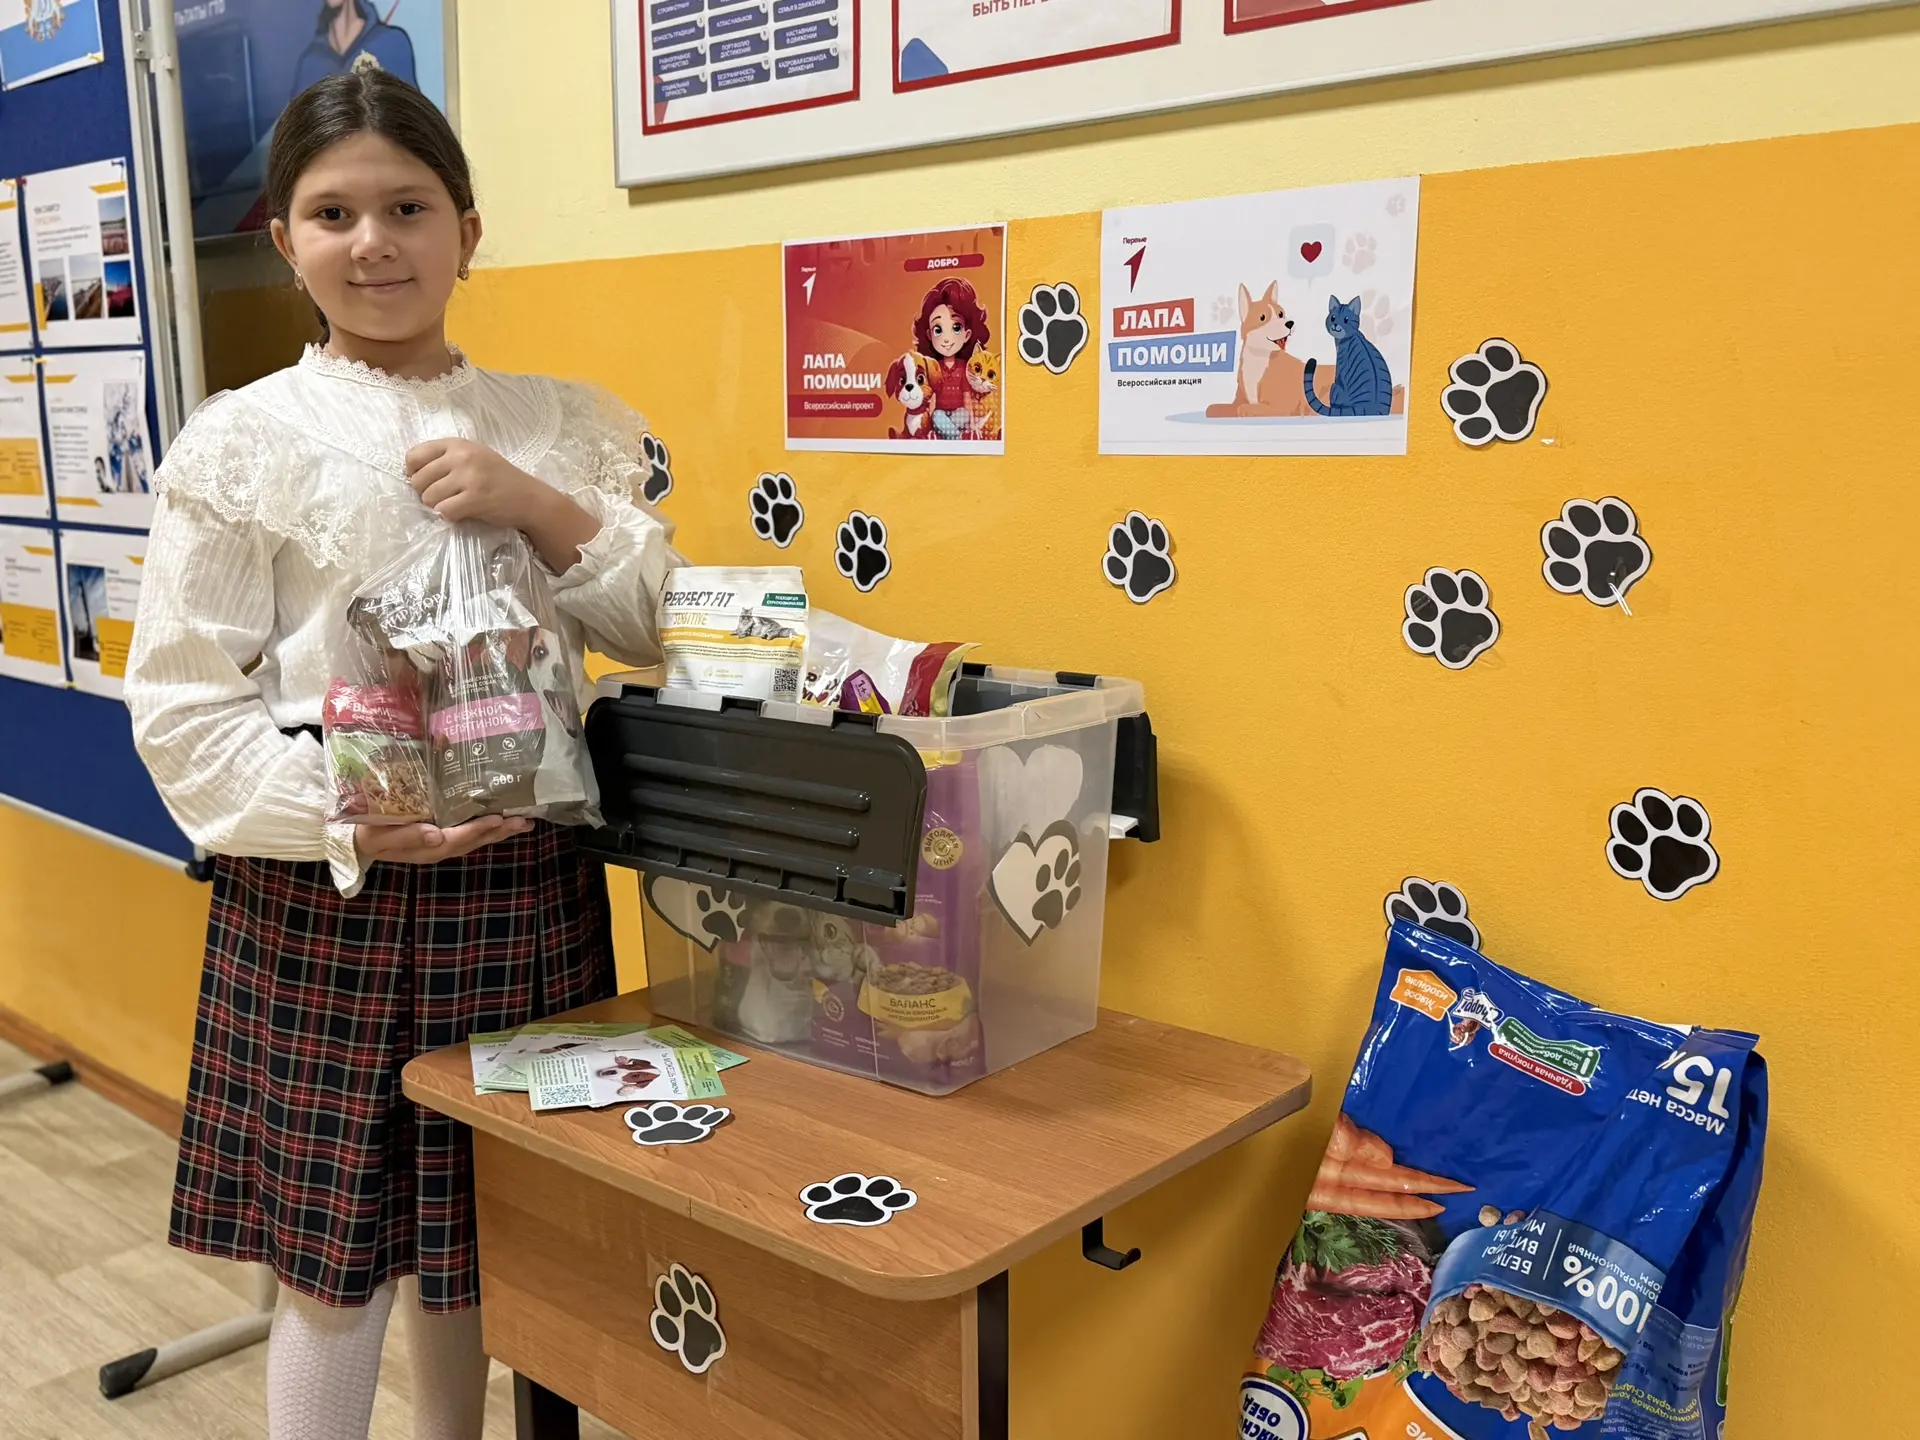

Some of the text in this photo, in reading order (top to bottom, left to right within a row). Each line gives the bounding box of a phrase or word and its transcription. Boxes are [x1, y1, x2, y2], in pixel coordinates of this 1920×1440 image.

[973, 0, 1010, 17] БЫТЬ
[1122, 236, 1148, 245] Первые
[927, 258, 959, 269] ДОБРО
[1120, 307, 1186, 331] ЛАПА
[802, 353, 846, 370] ЛАПА
[1117, 342, 1227, 367] ПОМОЩИ
[803, 373, 882, 391] ПОМОЩИ
[1117, 377, 1202, 389] Всероссийская акция
[804, 401, 875, 411] Всероссийский проект
[663, 591, 735, 608] PERFECT FIT
[924, 830, 959, 852] ВЫГОДНАЯ
[890, 998, 936, 1009] БАЛАНС
[1456, 999, 1500, 1024] Chappi
[1498, 1047, 1573, 1091] Удачная покупка
[1562, 1057, 1579, 1071] Без
[1665, 1055, 1732, 1119] 15
[1665, 1100, 1726, 1136] Масса
[1640, 1272, 1663, 1294] ОРМ
[1563, 1255, 1653, 1334] 100%
[1242, 1393, 1281, 1428] ОБЕД
